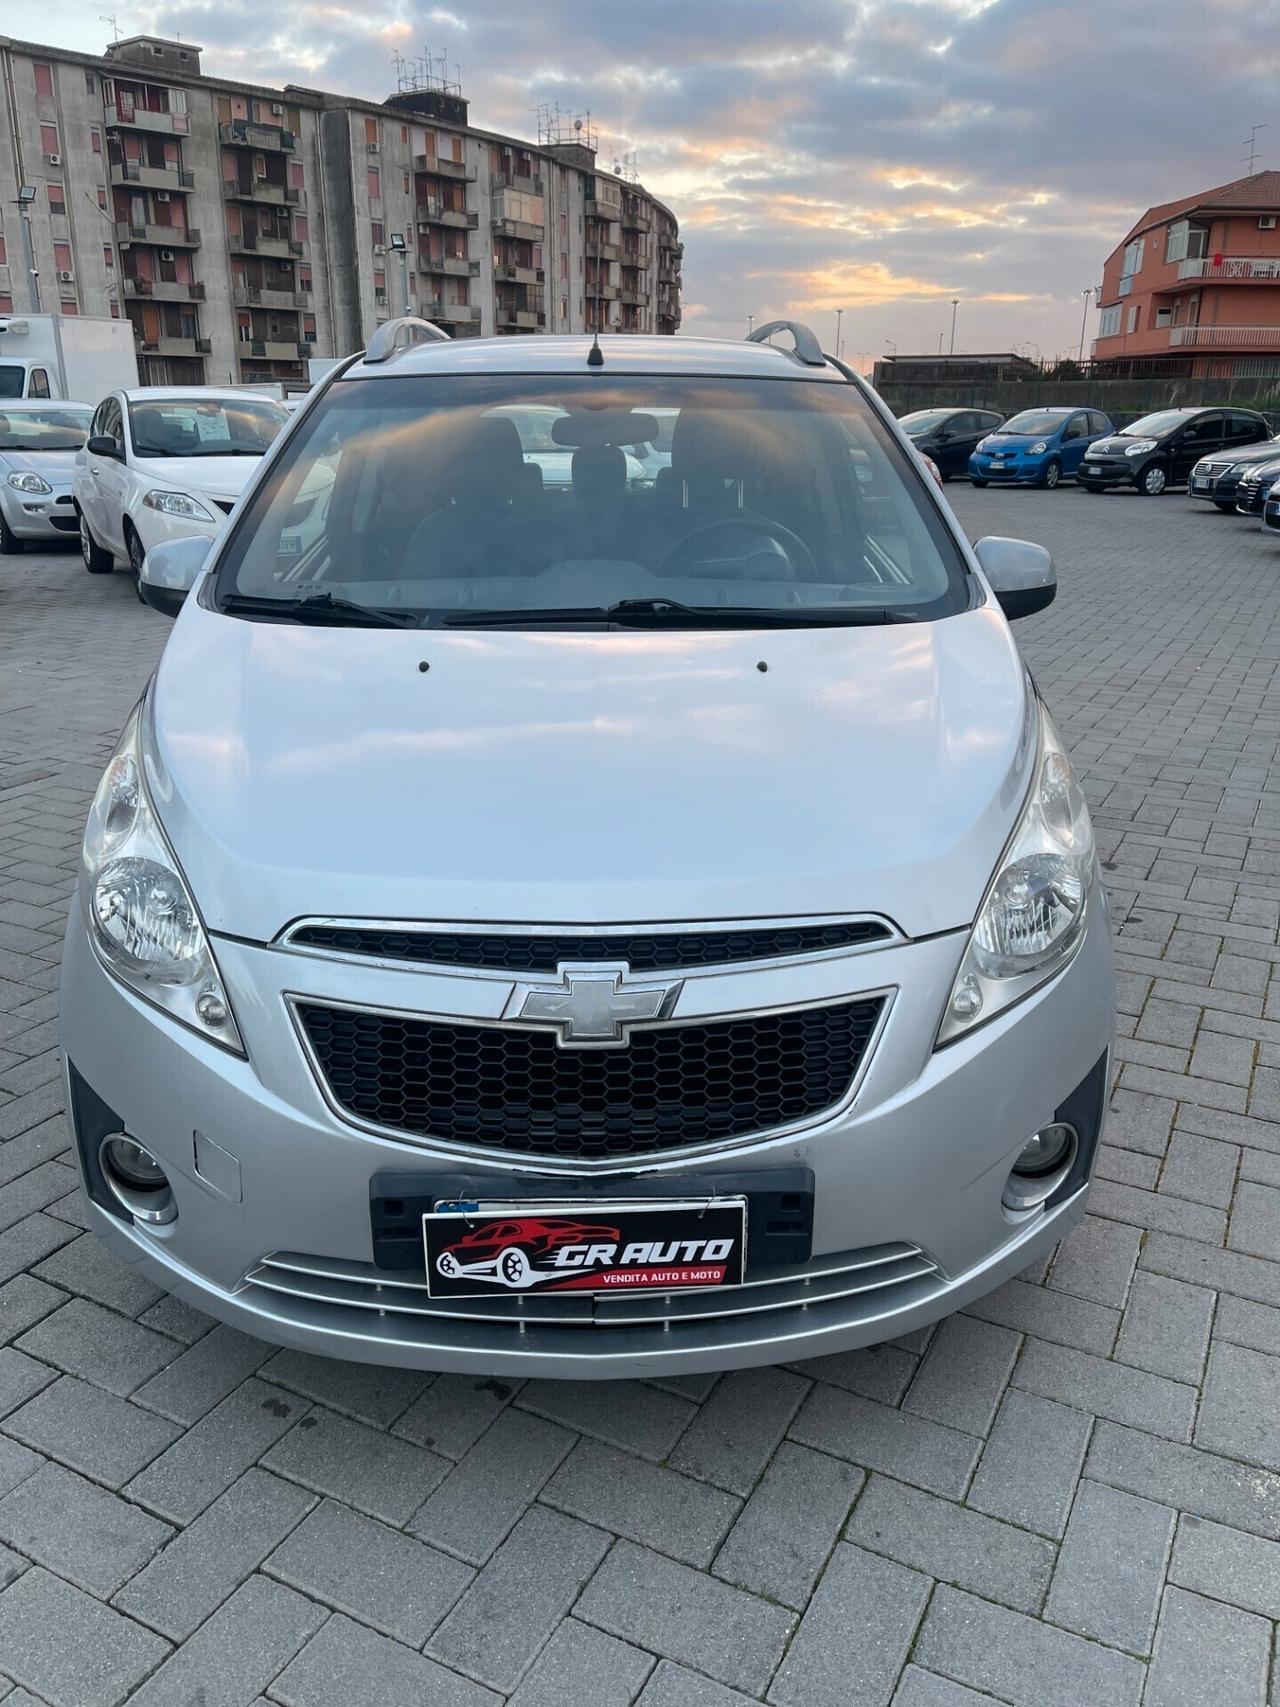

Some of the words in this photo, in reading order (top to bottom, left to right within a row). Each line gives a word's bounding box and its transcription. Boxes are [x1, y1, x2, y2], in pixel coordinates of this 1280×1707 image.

[554, 1244, 618, 1266] GR
[619, 1239, 735, 1264] AUTO
[603, 1274, 648, 1284] VENDITA
[651, 1272, 679, 1282] AUTO
[681, 1272, 688, 1280] E
[690, 1271, 721, 1280] MOTO
